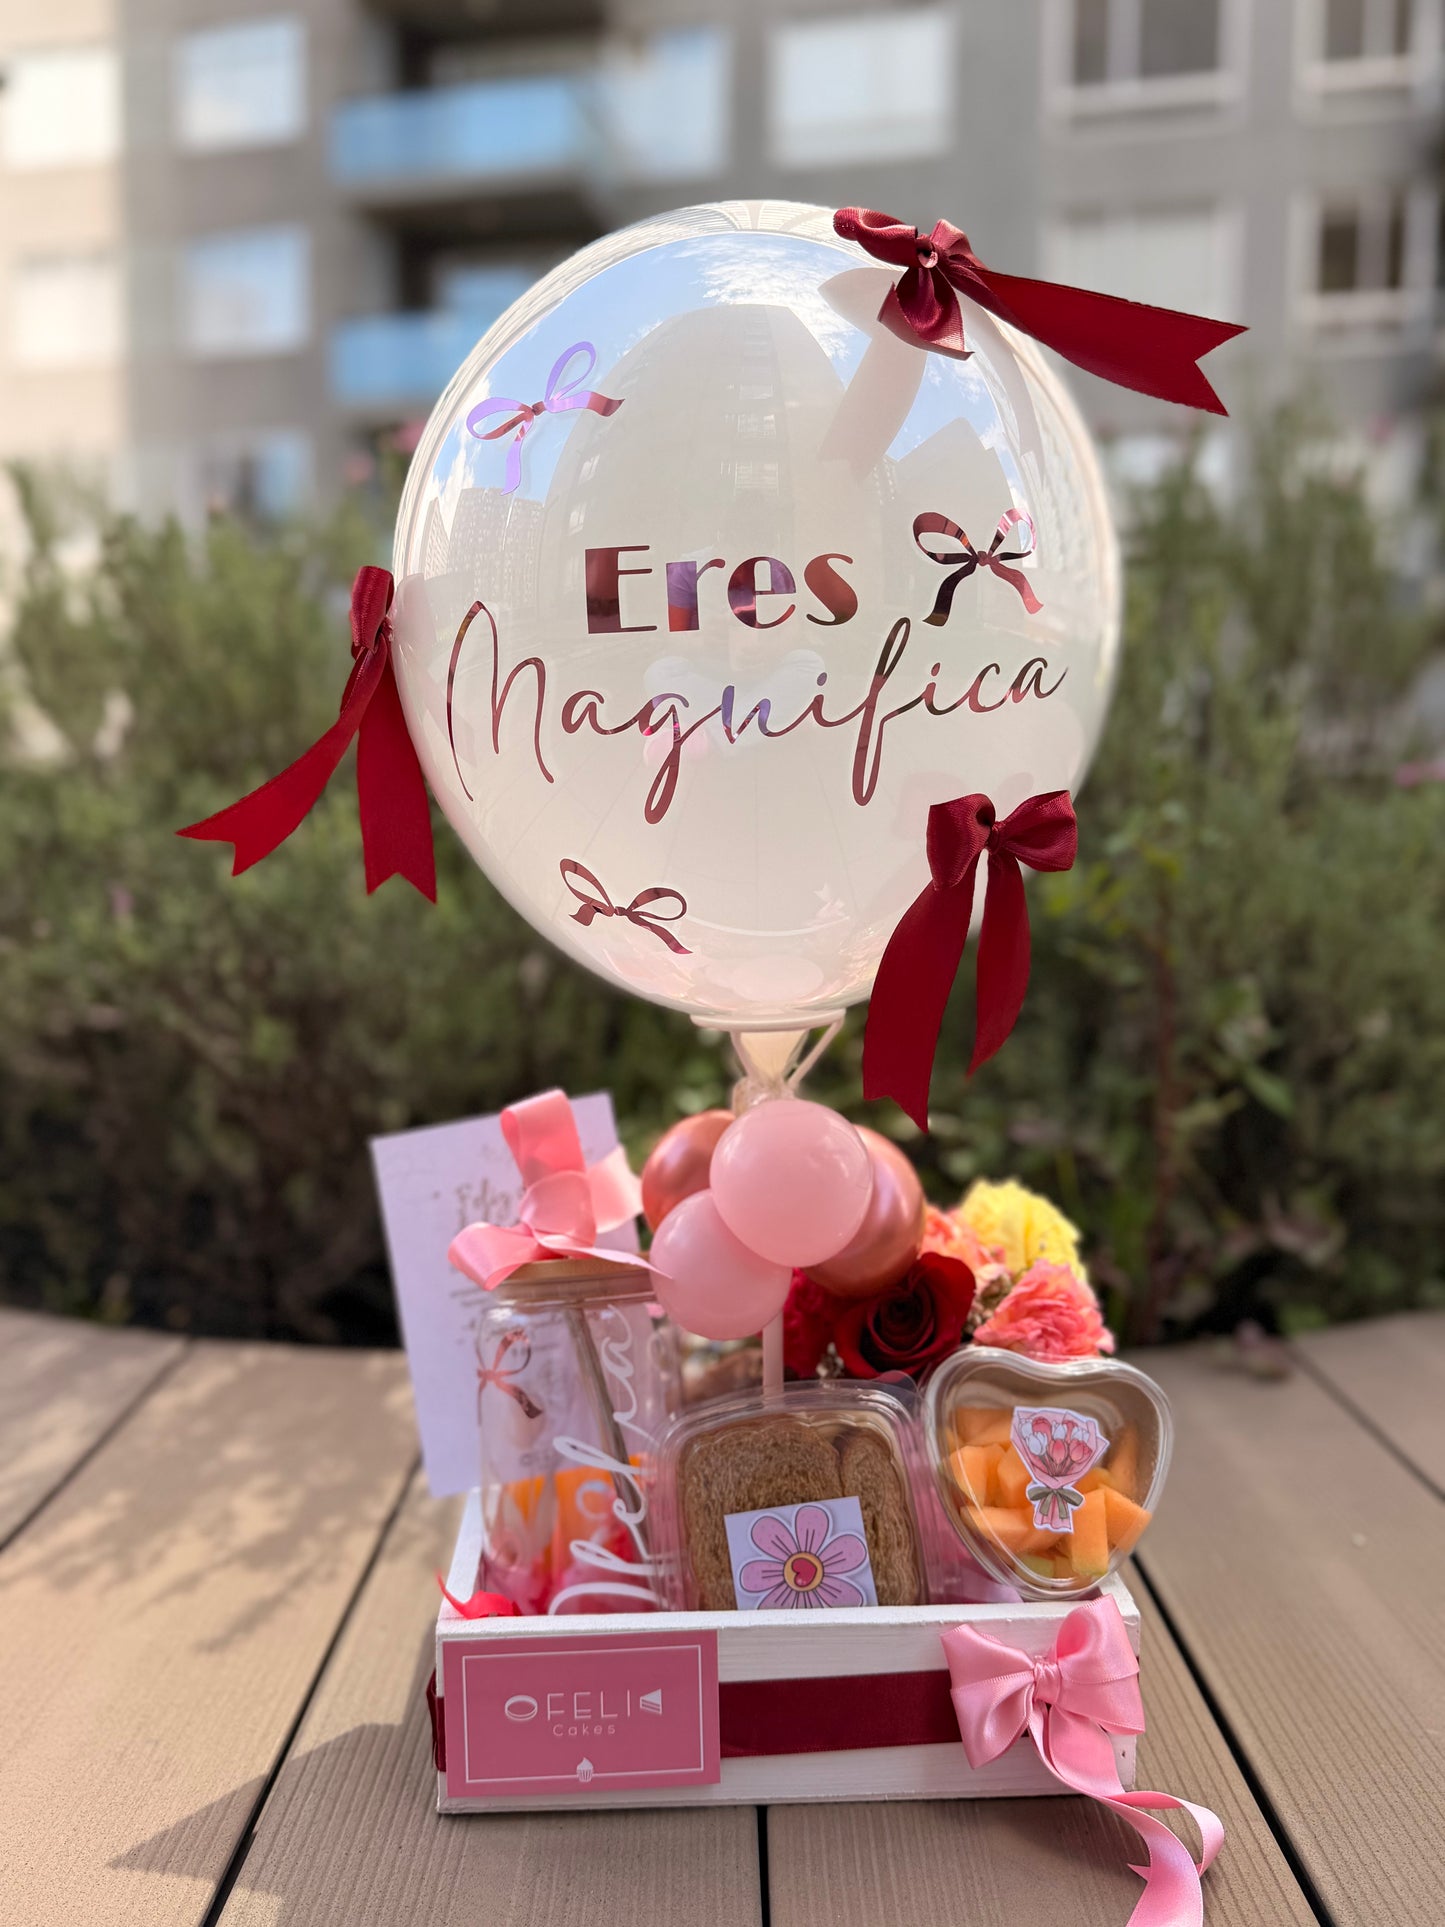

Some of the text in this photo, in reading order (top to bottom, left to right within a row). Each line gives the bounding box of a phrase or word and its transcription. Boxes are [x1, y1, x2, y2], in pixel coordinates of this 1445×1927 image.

[584, 544, 859, 635] Eres
[447, 600, 1069, 825] Magnifica
[552, 1723, 616, 1737] Cakes
